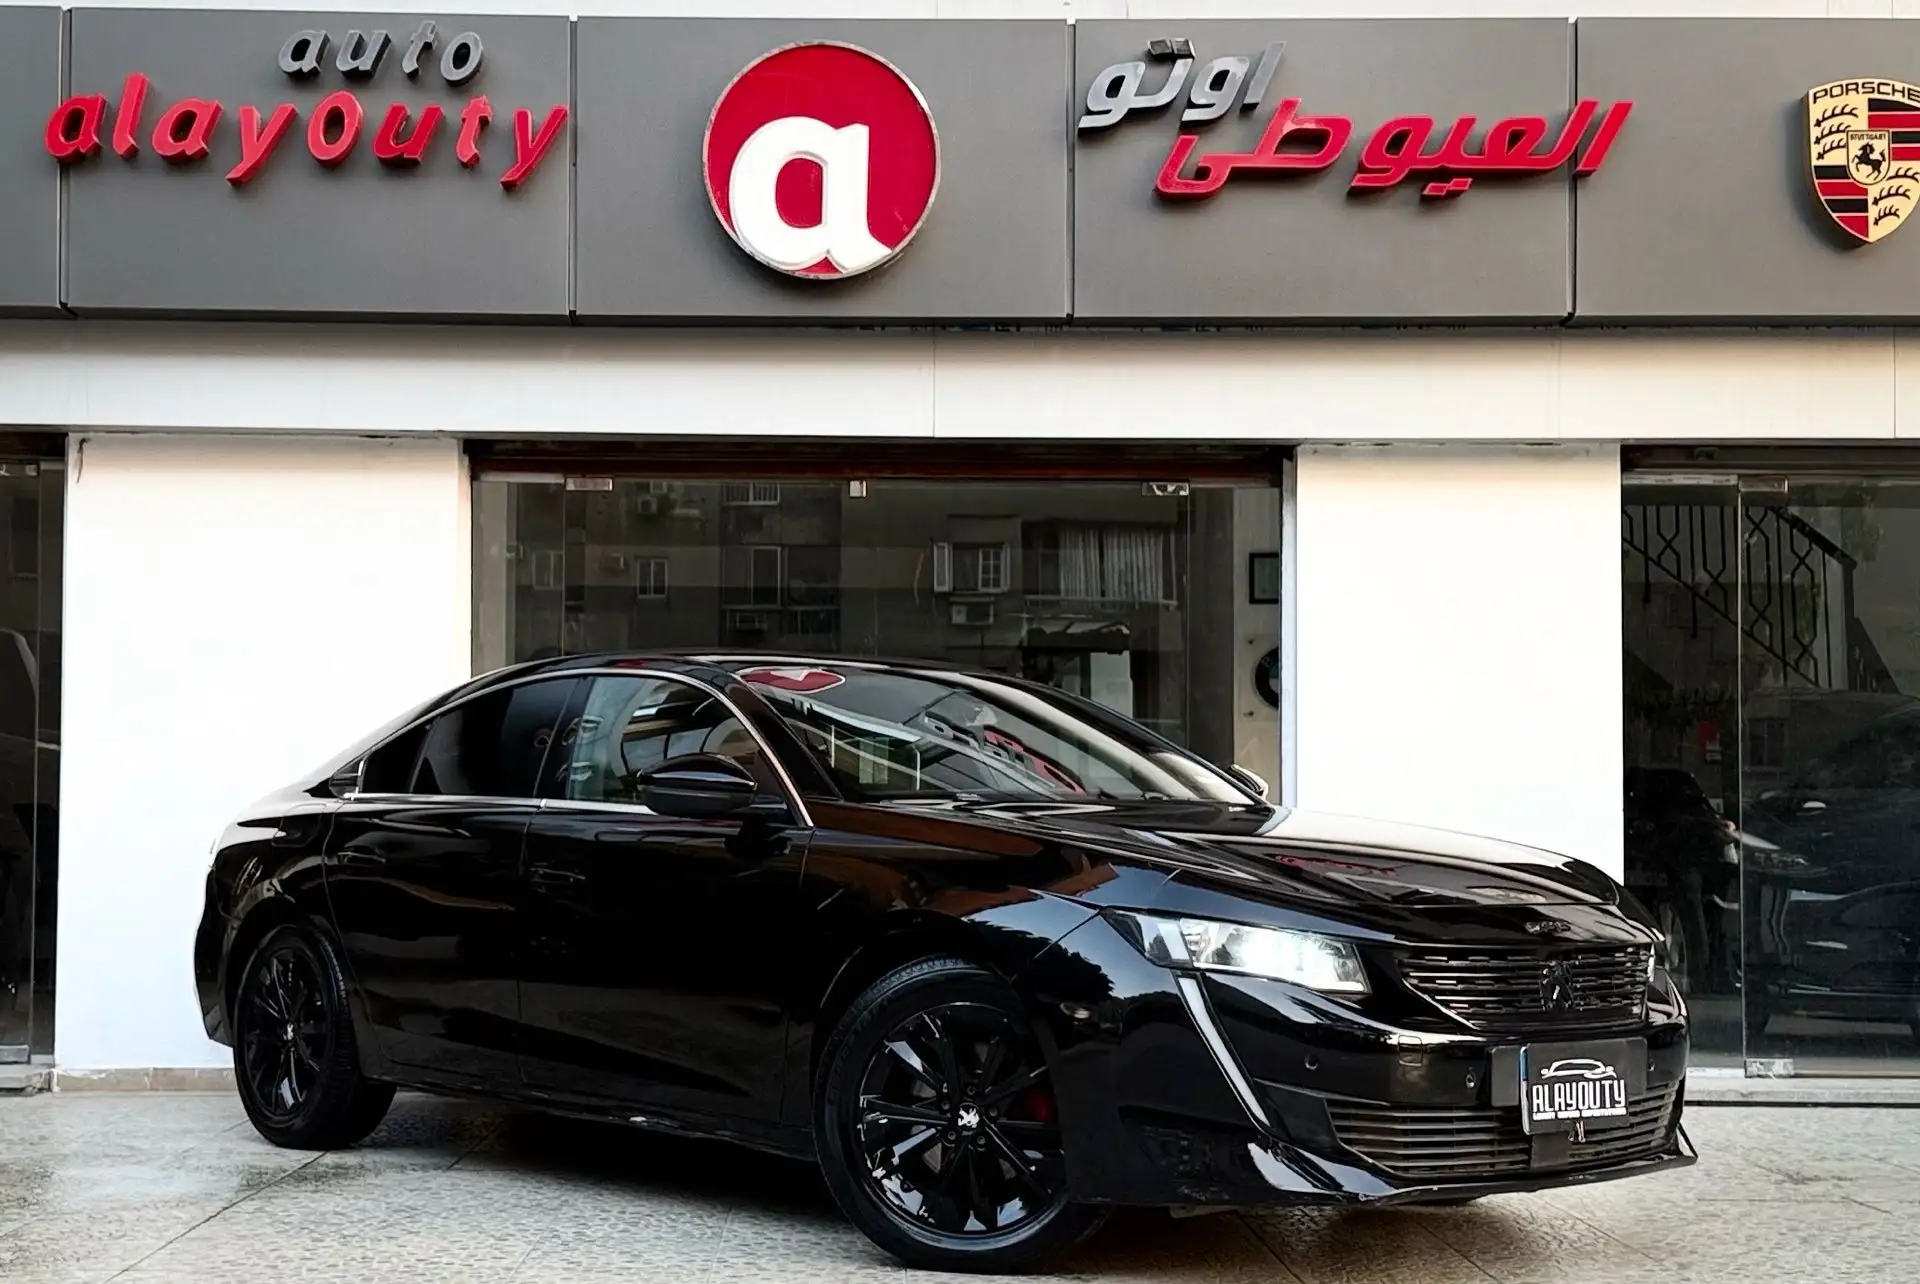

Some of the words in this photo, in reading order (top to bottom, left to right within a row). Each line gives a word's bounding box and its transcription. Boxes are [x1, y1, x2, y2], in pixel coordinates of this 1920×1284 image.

[278, 20, 485, 87] auto
[1813, 81, 1920, 104] PORSCHE
[729, 116, 893, 273] a
[1532, 1079, 1626, 1112] ALAYOUTY
